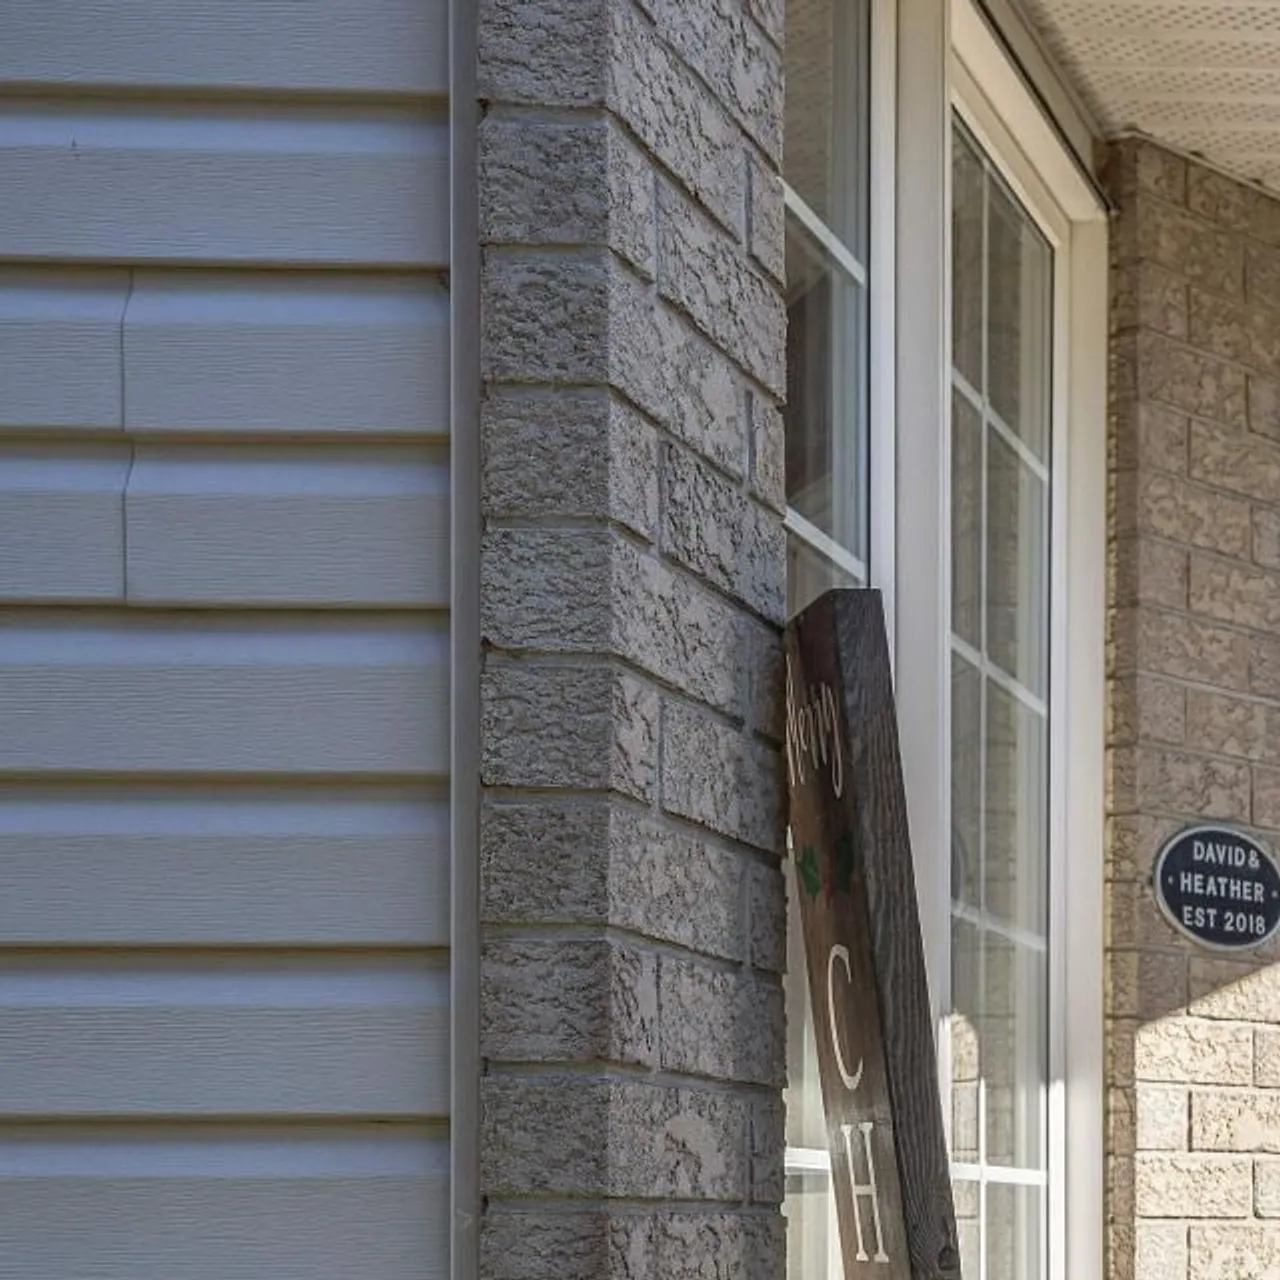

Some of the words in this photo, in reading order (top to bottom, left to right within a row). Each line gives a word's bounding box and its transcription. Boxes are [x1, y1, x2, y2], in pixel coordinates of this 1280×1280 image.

[1193, 840, 1245, 866] DAVID
[1180, 872, 1265, 903] HEATHER
[1183, 905, 1217, 929] EST
[1224, 911, 1266, 935] 2018
